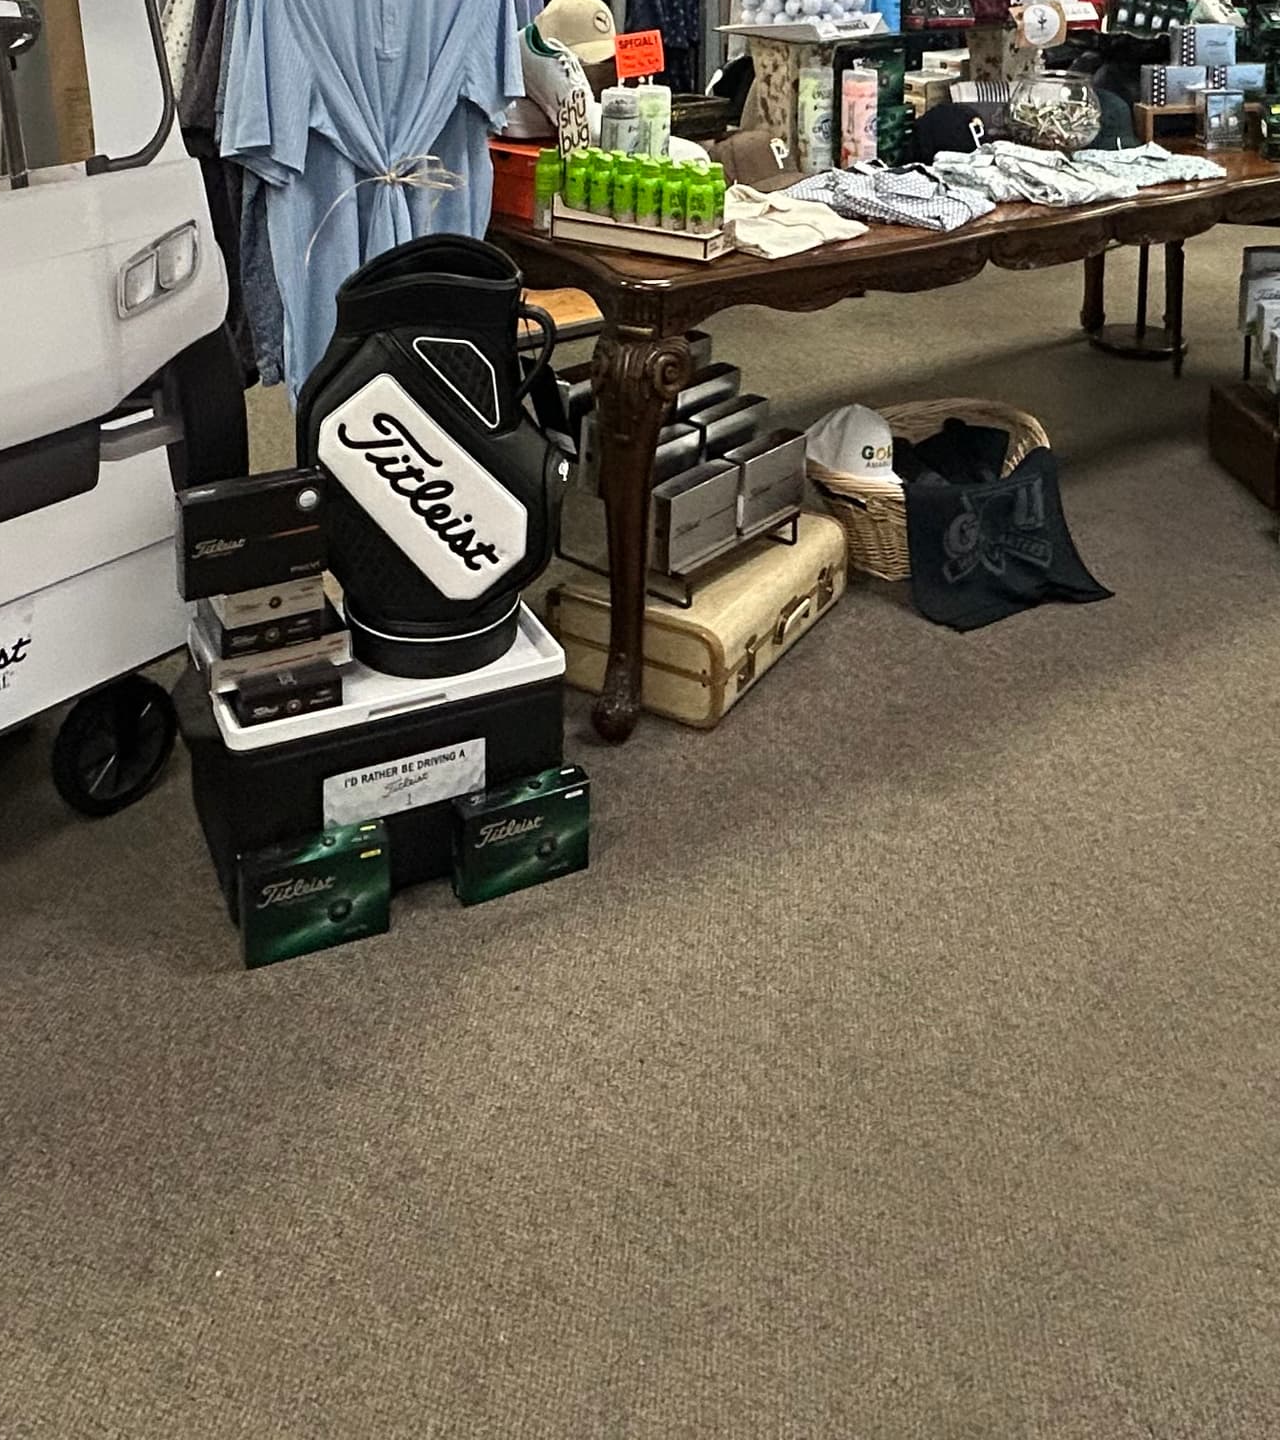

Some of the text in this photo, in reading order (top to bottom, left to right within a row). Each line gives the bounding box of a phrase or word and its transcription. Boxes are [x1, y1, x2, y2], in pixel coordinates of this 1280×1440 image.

[561, 121, 590, 153] bug
[338, 410, 502, 574] Titleist
[344, 749, 466, 789] I'D RATHER BE DRIVING A
[382, 771, 429, 799] Titleist
[474, 814, 546, 849] Titleist
[256, 875, 338, 909] Titleist
